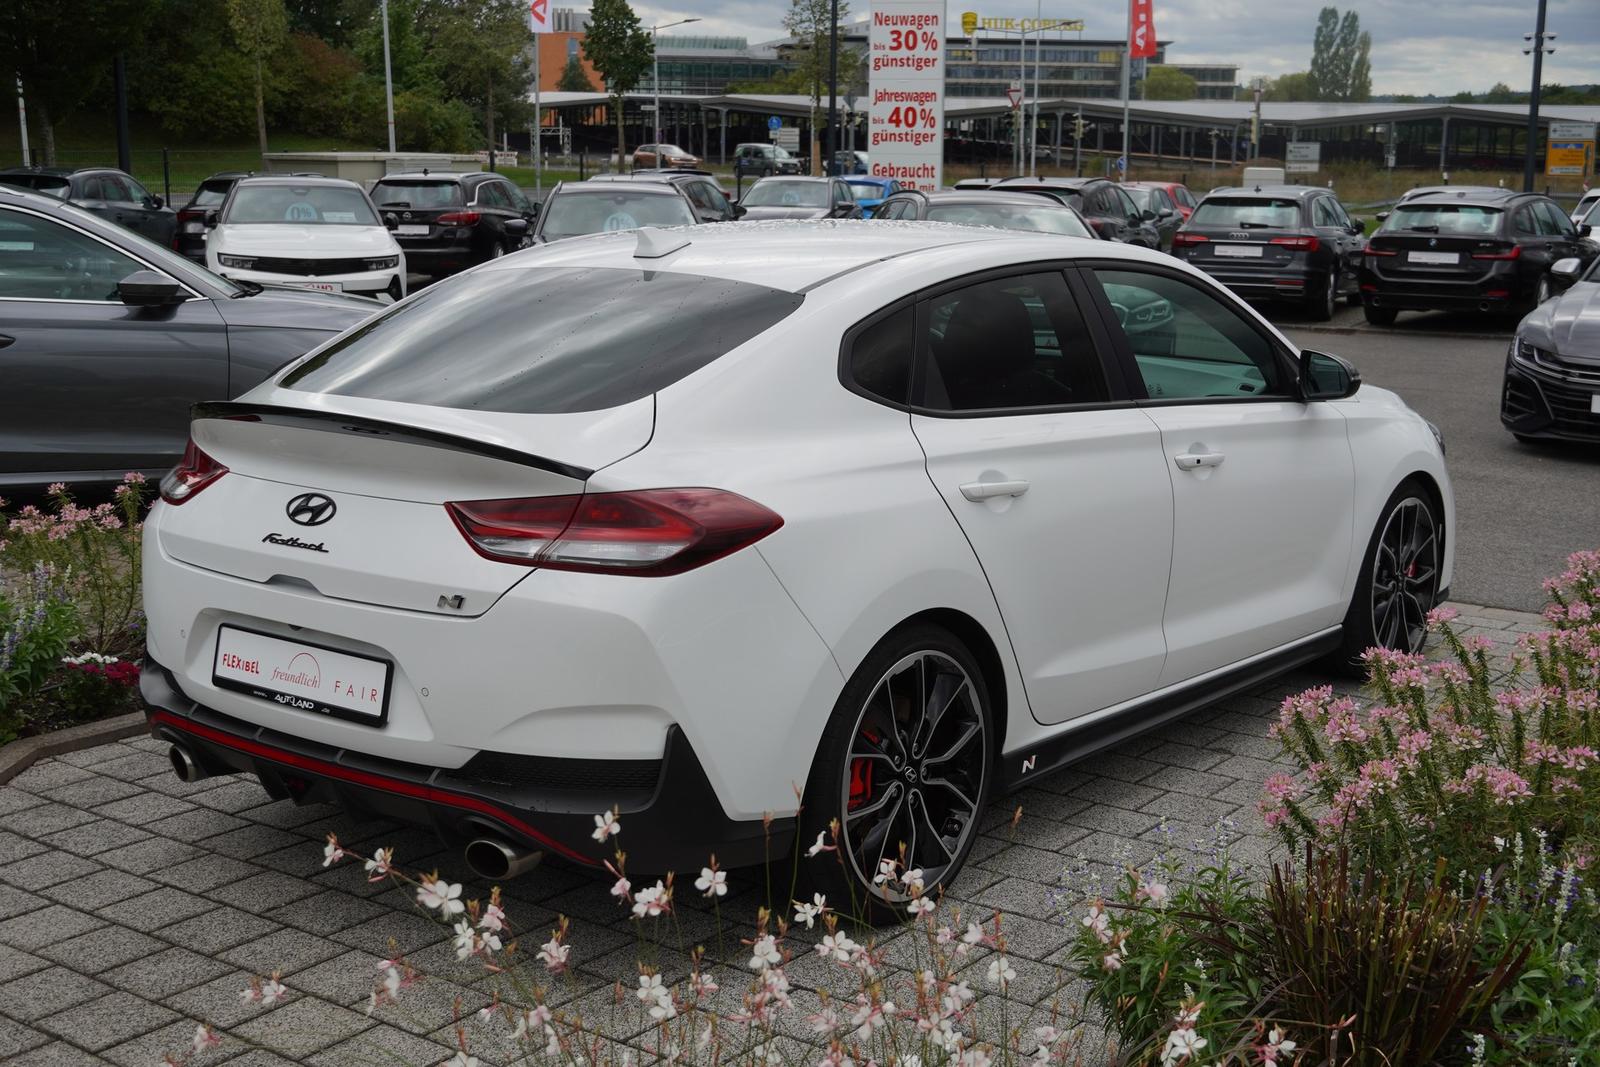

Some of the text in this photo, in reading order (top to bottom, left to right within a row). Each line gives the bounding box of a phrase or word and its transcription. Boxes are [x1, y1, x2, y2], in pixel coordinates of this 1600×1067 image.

[874, 12, 939, 28] Neuwagen
[873, 55, 938, 71] günstiger
[873, 89, 937, 104] Jahreswagen
[872, 130, 936, 146] günstiger
[872, 162, 936, 178] Gebraucht
[261, 532, 330, 553] Fastback
[270, 666, 318, 689] freundlich
[274, 693, 315, 710] AUTOLAND
[1021, 754, 1037, 774] N
